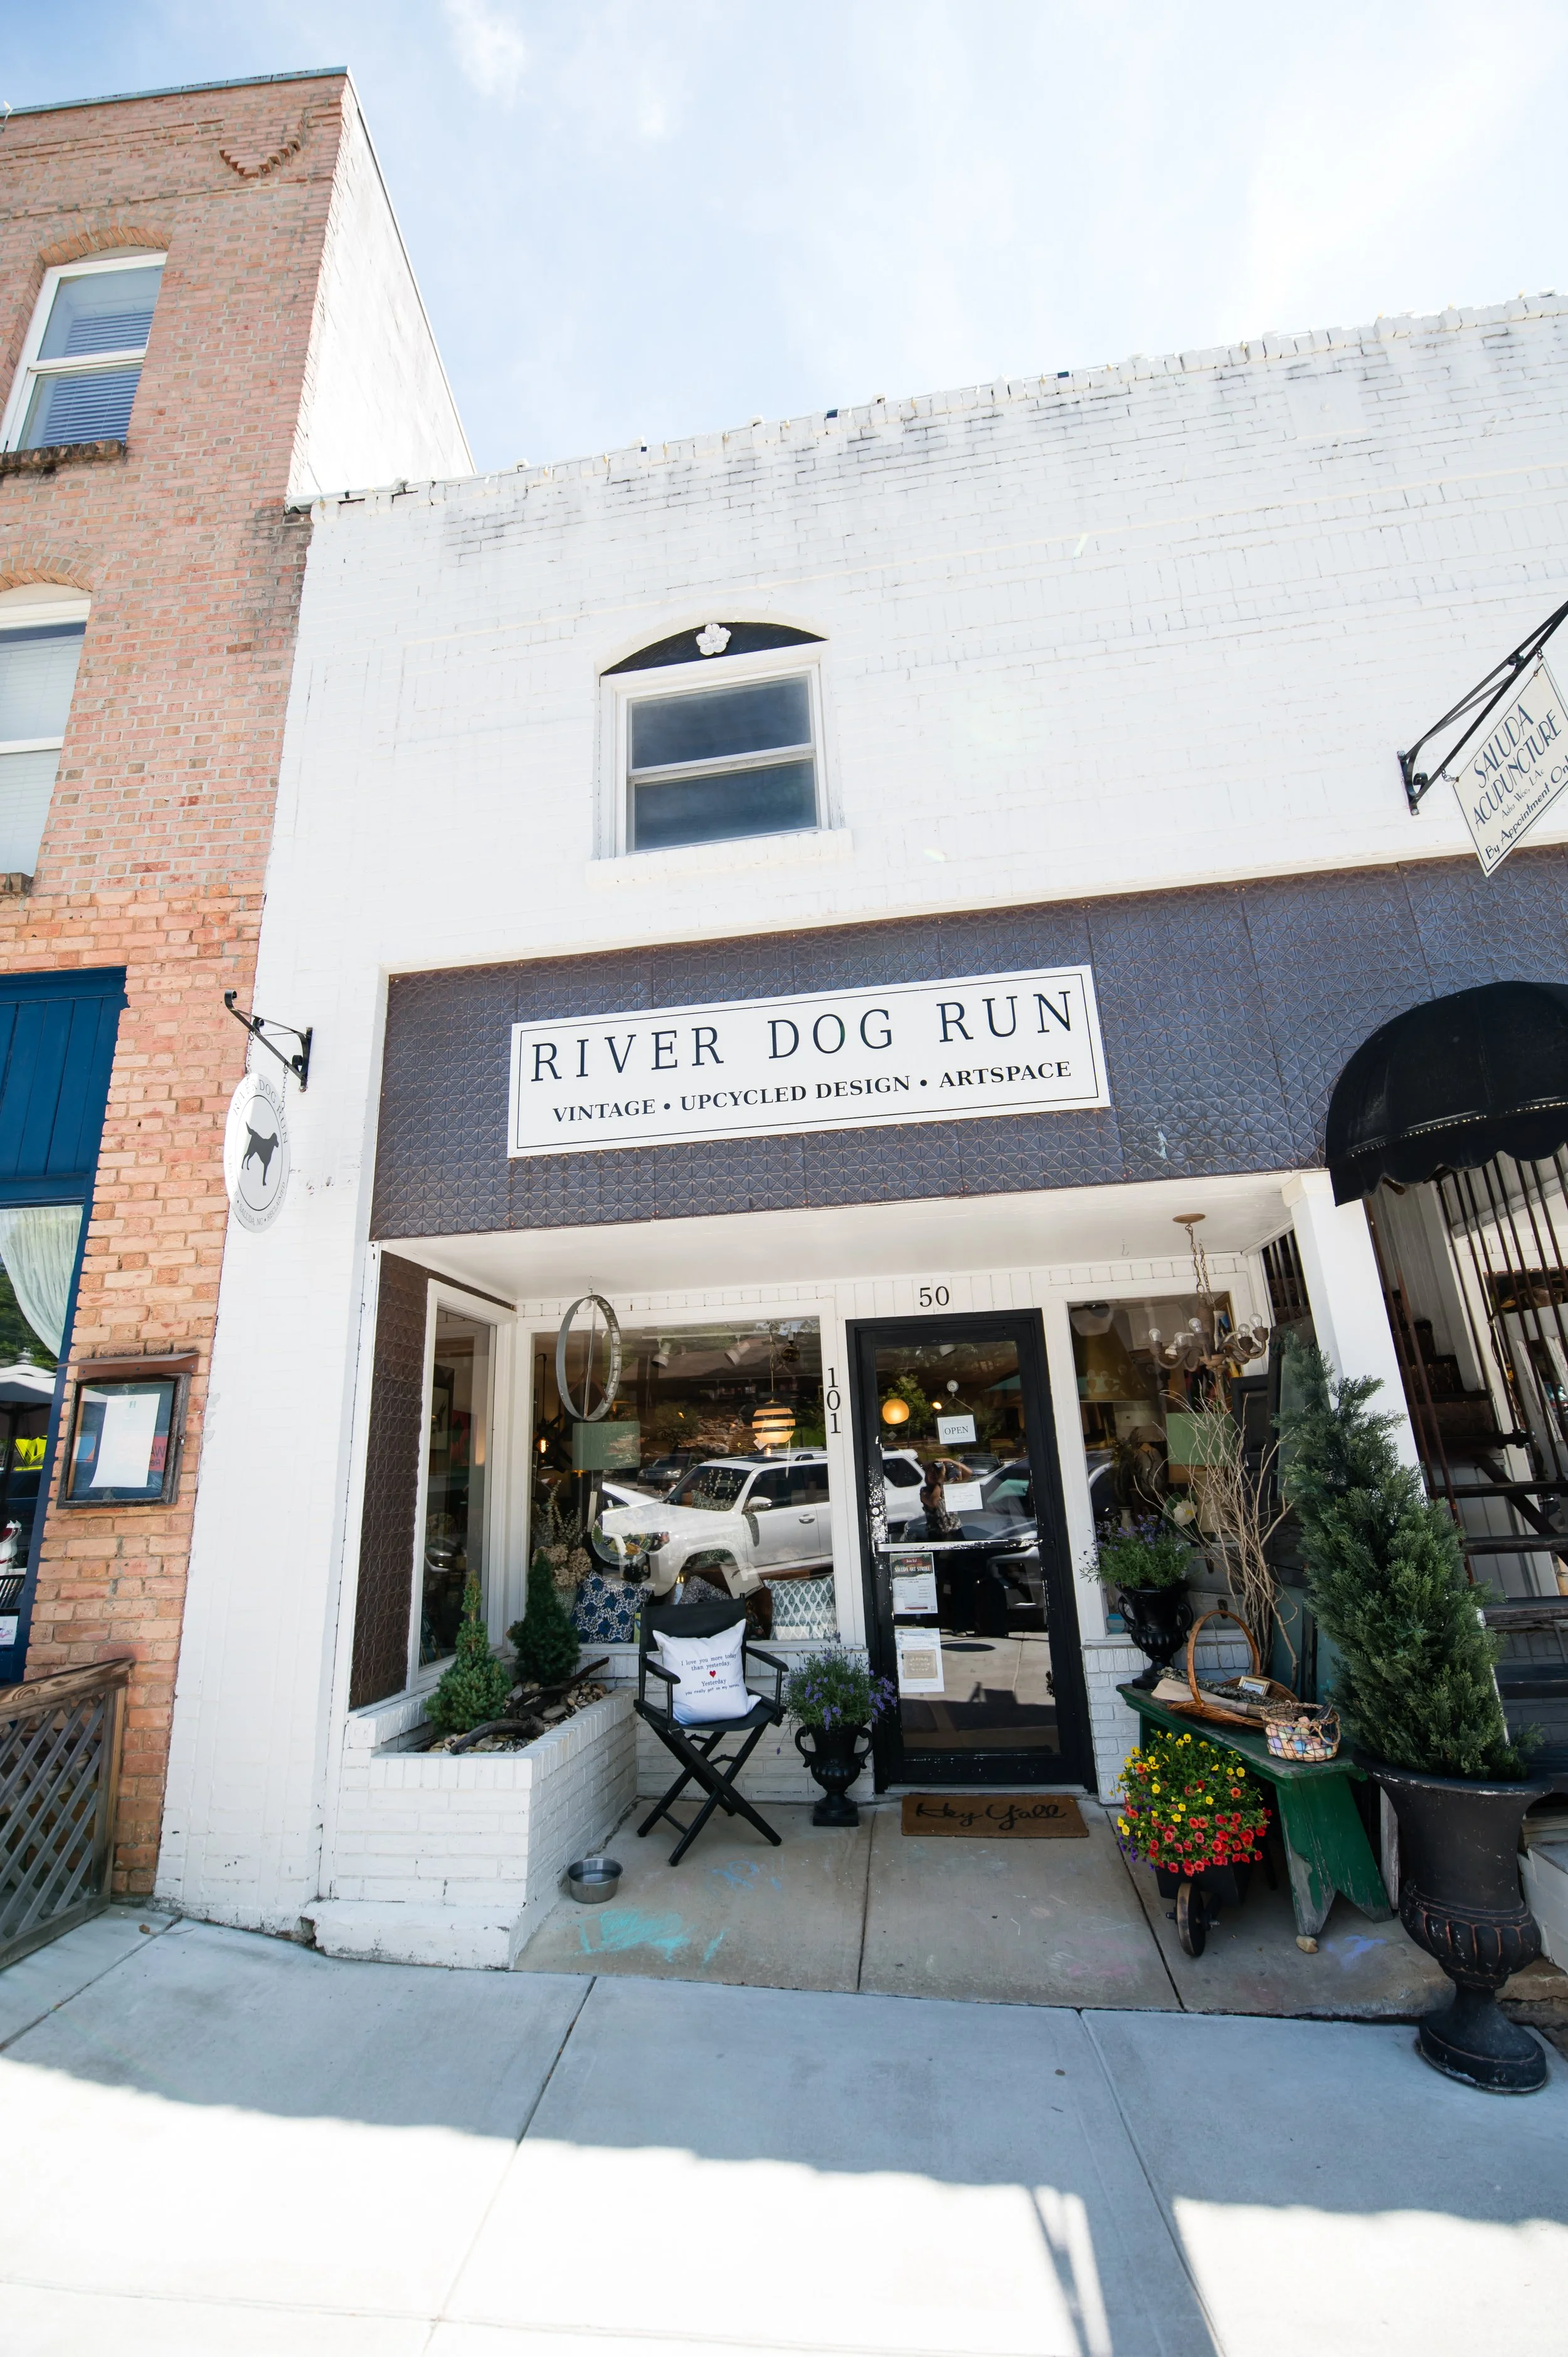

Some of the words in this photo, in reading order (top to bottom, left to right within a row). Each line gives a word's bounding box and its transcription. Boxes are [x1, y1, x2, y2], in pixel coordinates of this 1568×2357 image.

[1474, 703, 1534, 789] SALUDA
[1474, 709, 1562, 832] ACUPUNCTURE
[1485, 844, 1500, 859] By
[1501, 782, 1550, 845] Appointment
[1502, 804, 1515, 821] Asha
[531, 1027, 724, 1082] RIVER
[767, 1009, 892, 1059] DOG
[936, 991, 1071, 1044] RUN
[258, 1079, 277, 1104] DOG
[277, 1105, 288, 1144] RUN
[553, 1099, 655, 1122] VINTAGE
[681, 1086, 807, 1111] UPCYCLED
[815, 1076, 910, 1099] DESIGN
[939, 1061, 1071, 1088] ARTSPACE
[919, 1286, 950, 1307] 50
[826, 1367, 842, 1434] 101
[944, 1425, 969, 1435] OPEN
[915, 1802, 983, 1827] Hey
[985, 1804, 1066, 1831] Y'all
